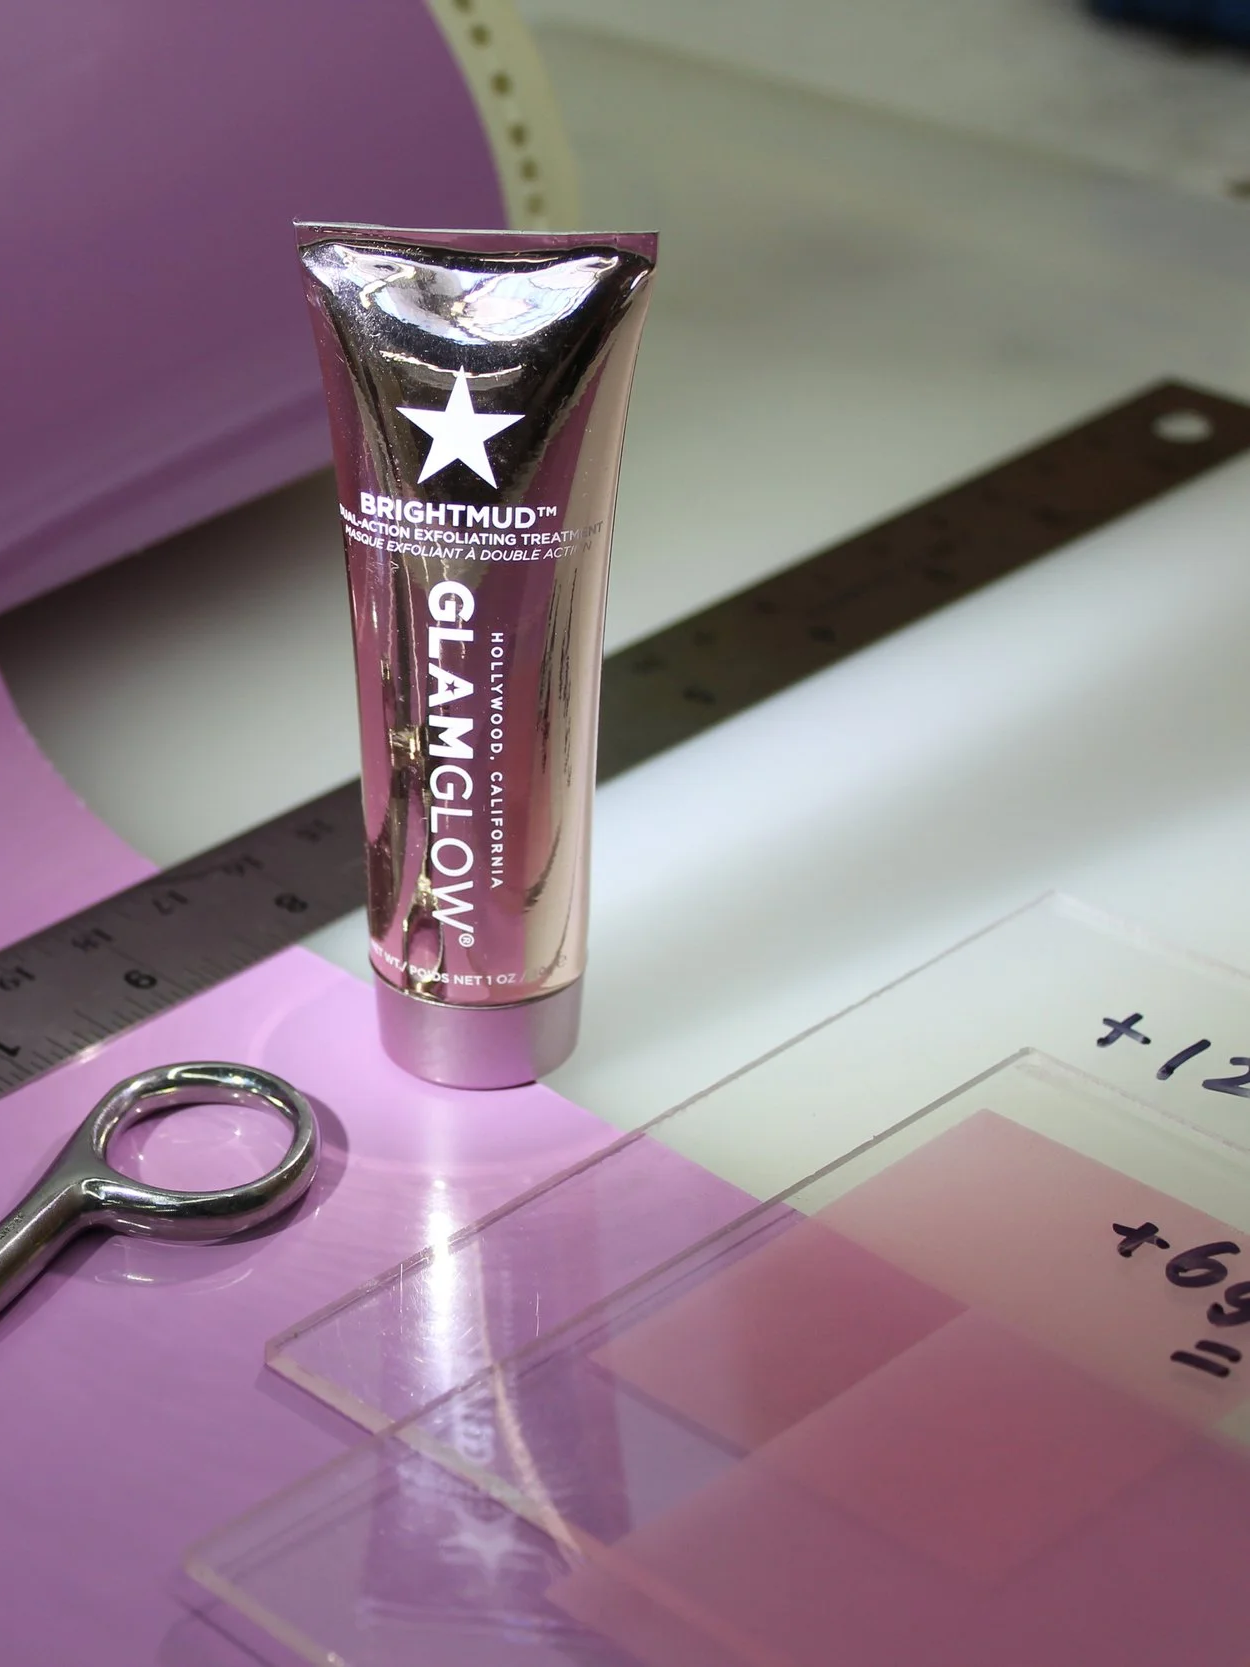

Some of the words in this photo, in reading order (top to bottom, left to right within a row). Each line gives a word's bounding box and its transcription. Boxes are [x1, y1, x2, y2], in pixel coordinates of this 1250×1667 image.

[345, 525, 384, 549] MASQUE
[386, 541, 463, 559] EXFOLIANT
[542, 541, 593, 560] ACTIN
[414, 528, 517, 545] EXFOLIATING
[489, 771, 505, 890] CALIFORNIA
[454, 974, 483, 985] NET
[486, 975, 492, 985] 1
[496, 973, 516, 985] OZ
